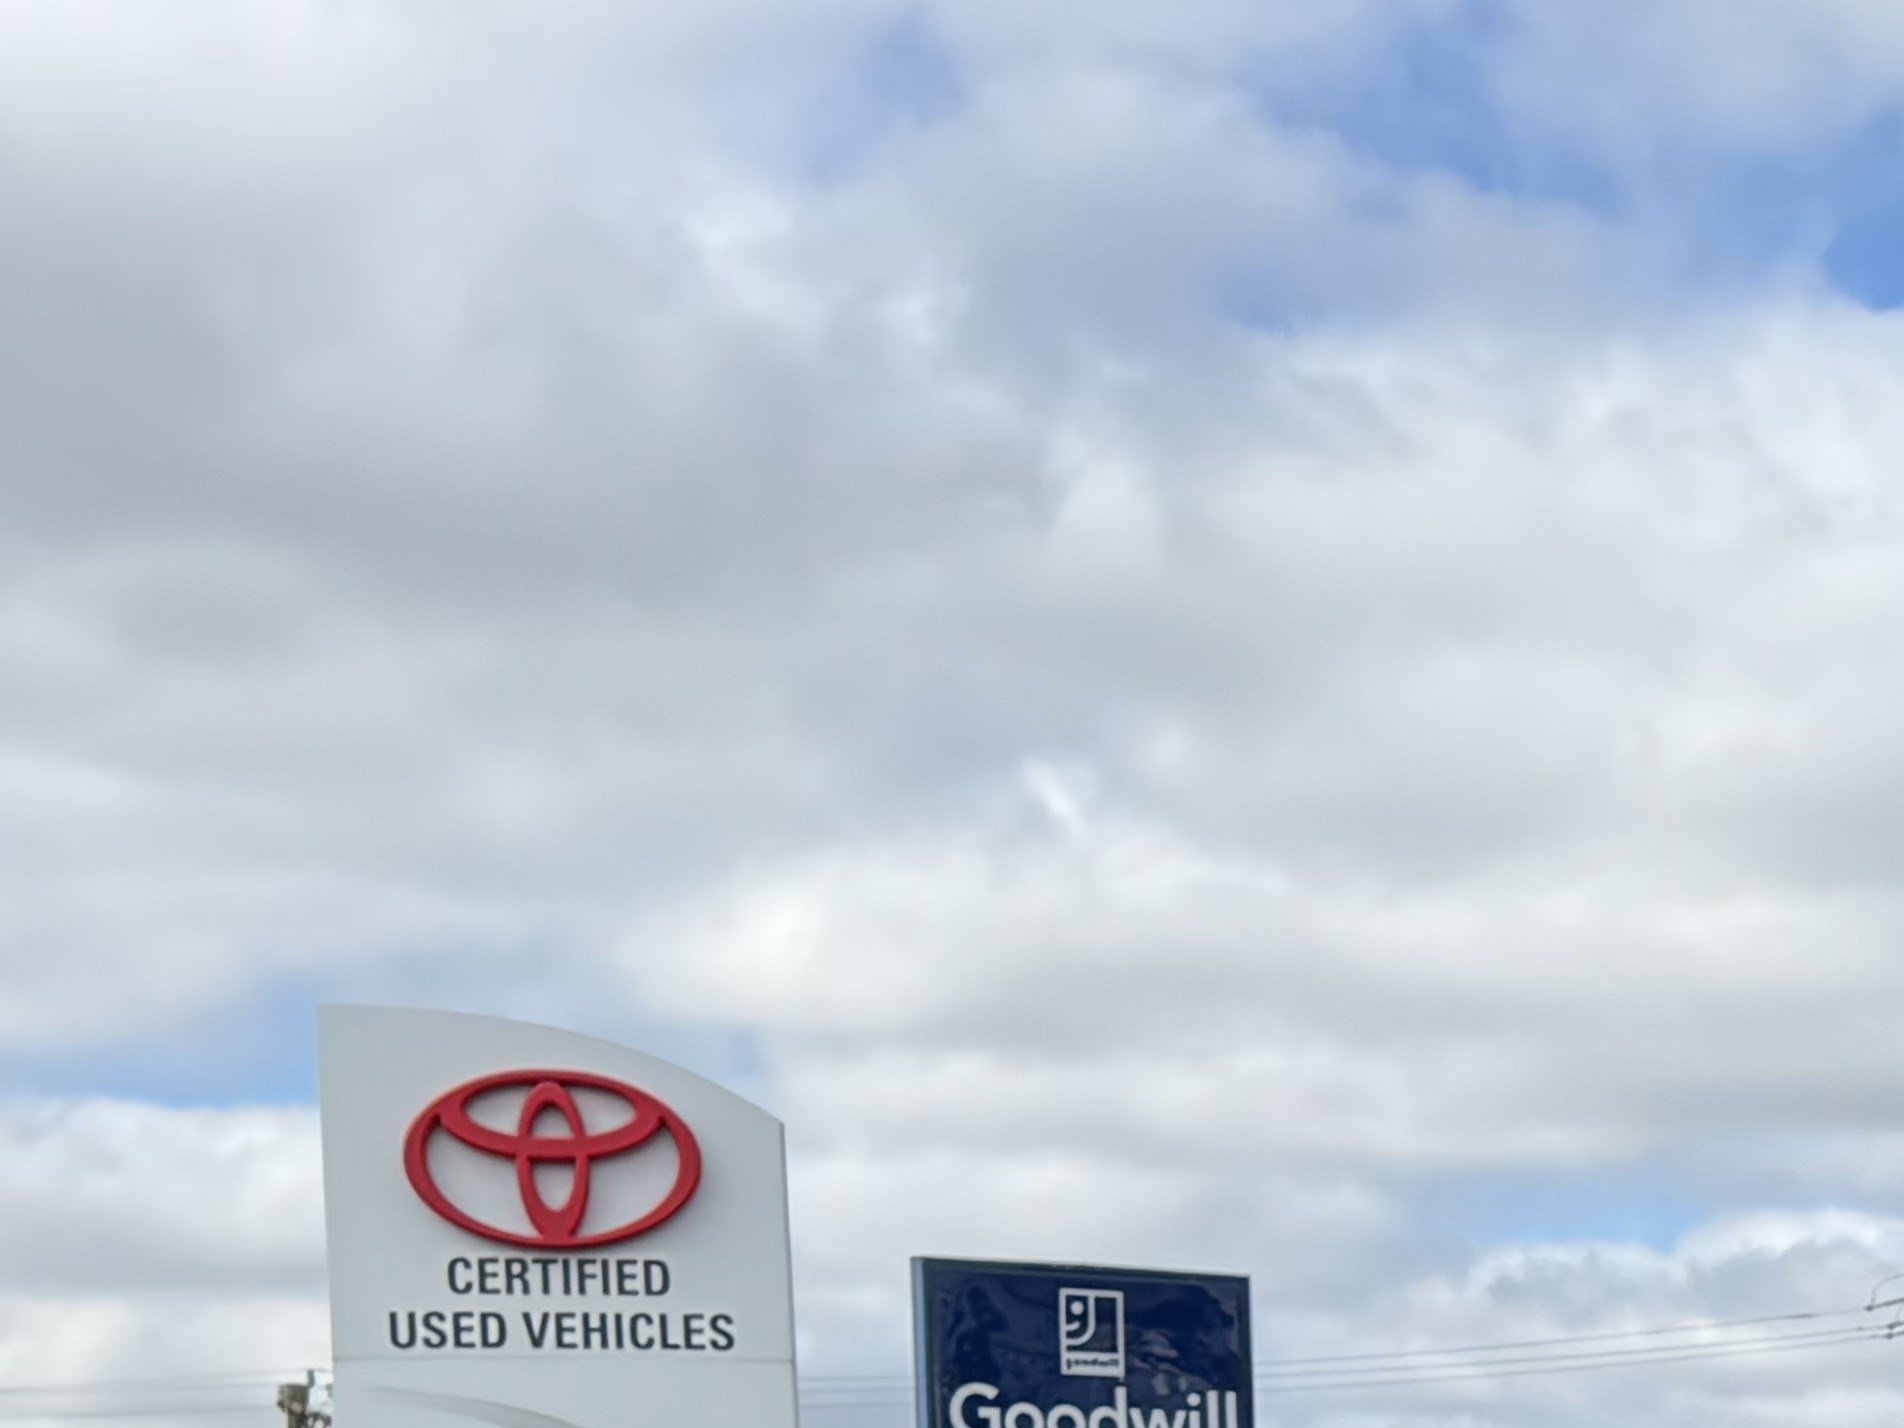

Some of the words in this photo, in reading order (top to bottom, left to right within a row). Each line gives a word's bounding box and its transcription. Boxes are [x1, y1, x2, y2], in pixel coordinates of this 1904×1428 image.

[448, 1257, 670, 1297] CERTIFIED
[389, 1311, 507, 1350] USED
[521, 1312, 735, 1351] VEHICLES
